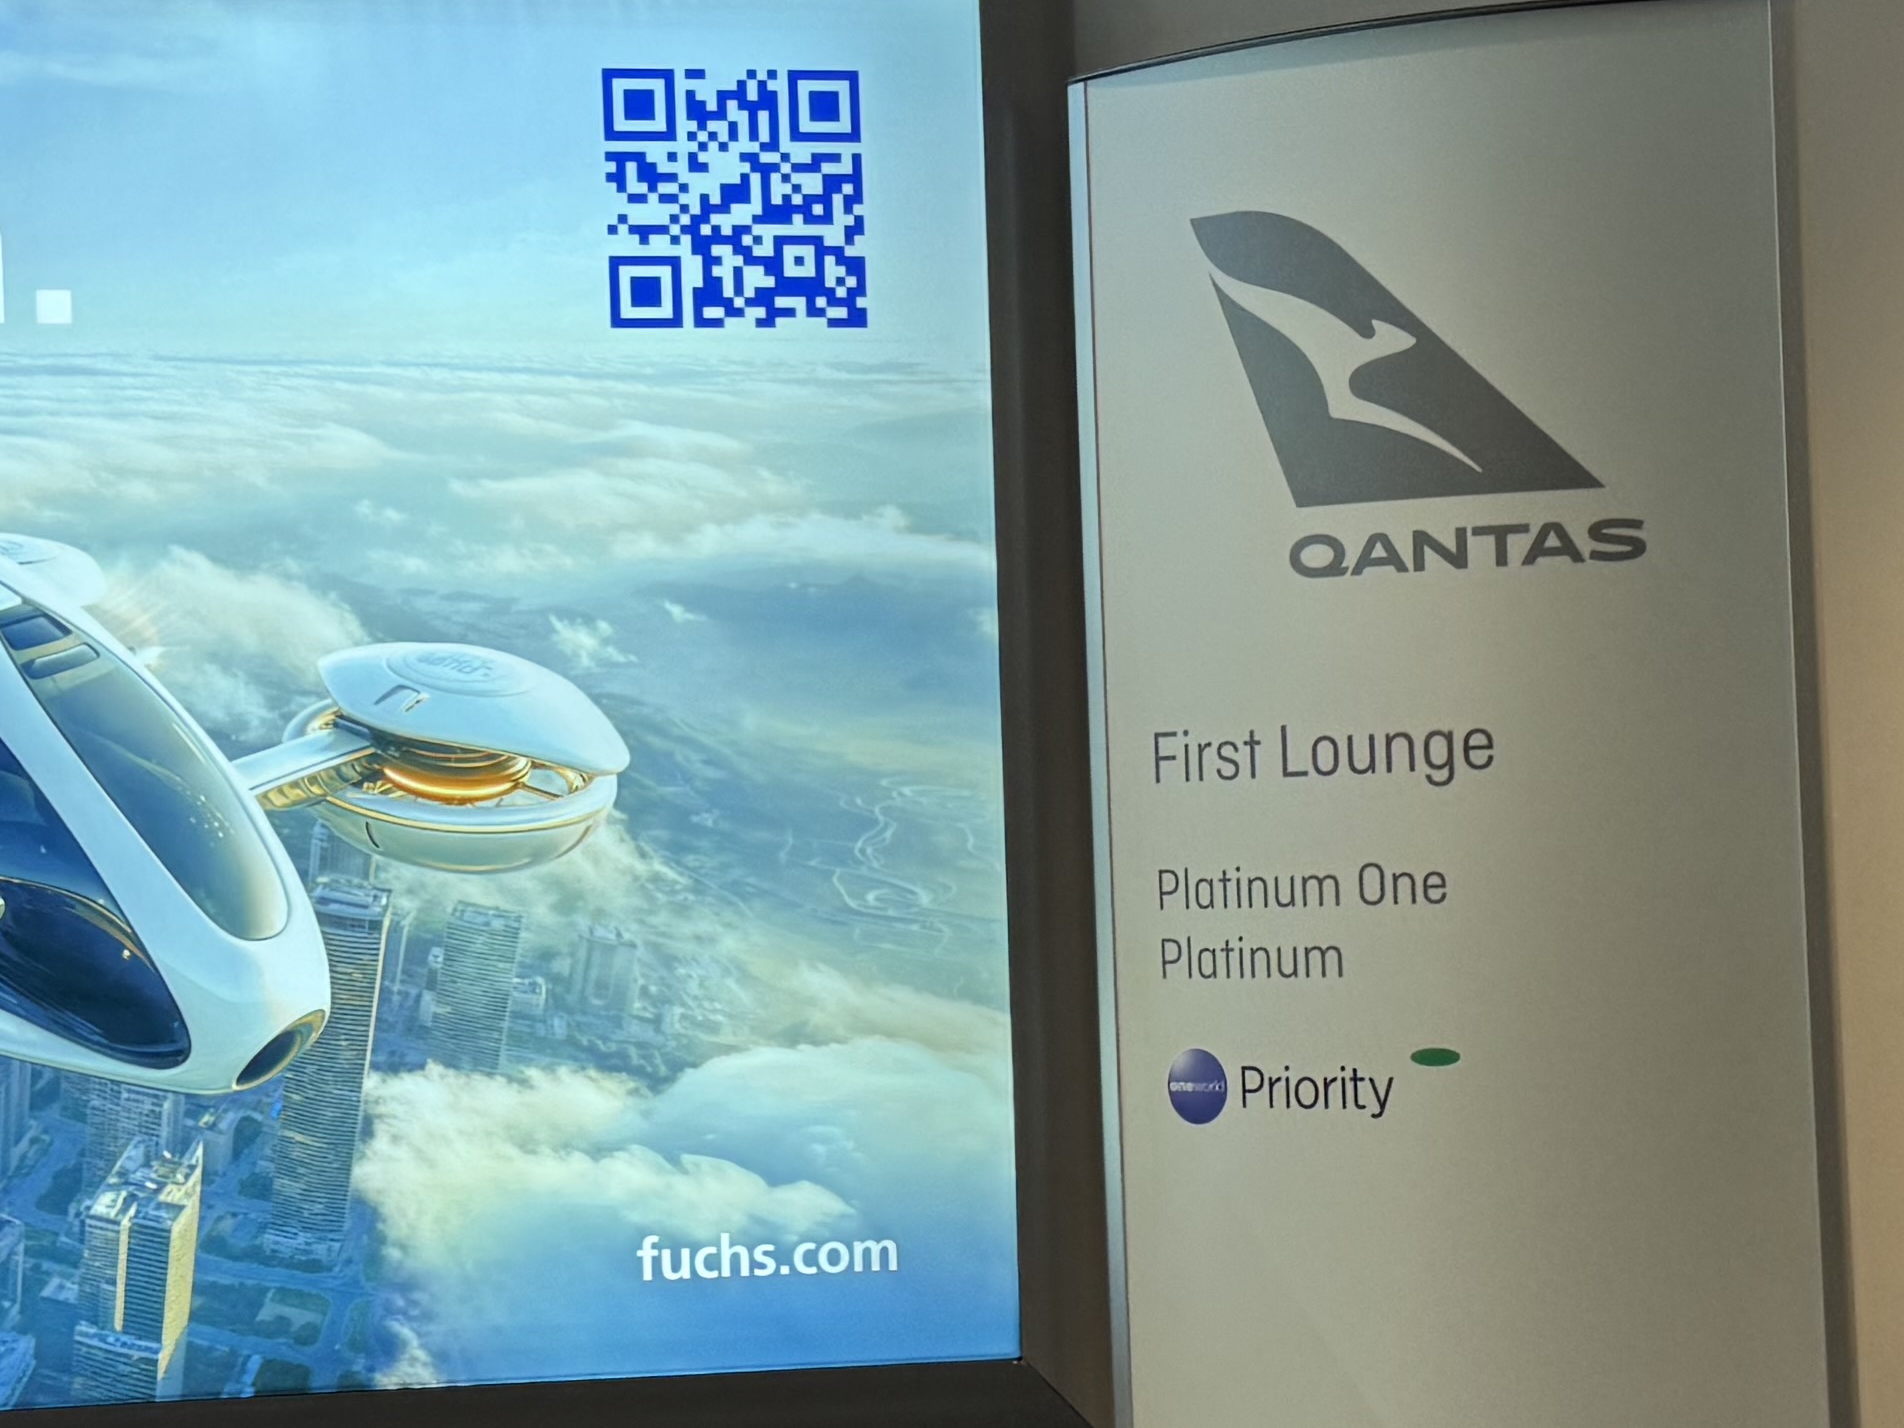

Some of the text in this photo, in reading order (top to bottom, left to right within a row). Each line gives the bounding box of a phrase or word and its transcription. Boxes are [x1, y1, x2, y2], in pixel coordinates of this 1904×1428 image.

[1288, 517, 1648, 580] QANTAS
[1153, 724, 1495, 788] First Lounge
[1158, 862, 1448, 910] Platinum One
[1160, 935, 1344, 980] Platinum
[1240, 1065, 1394, 1119] Priority
[637, 1232, 898, 1282] fuchs.com
